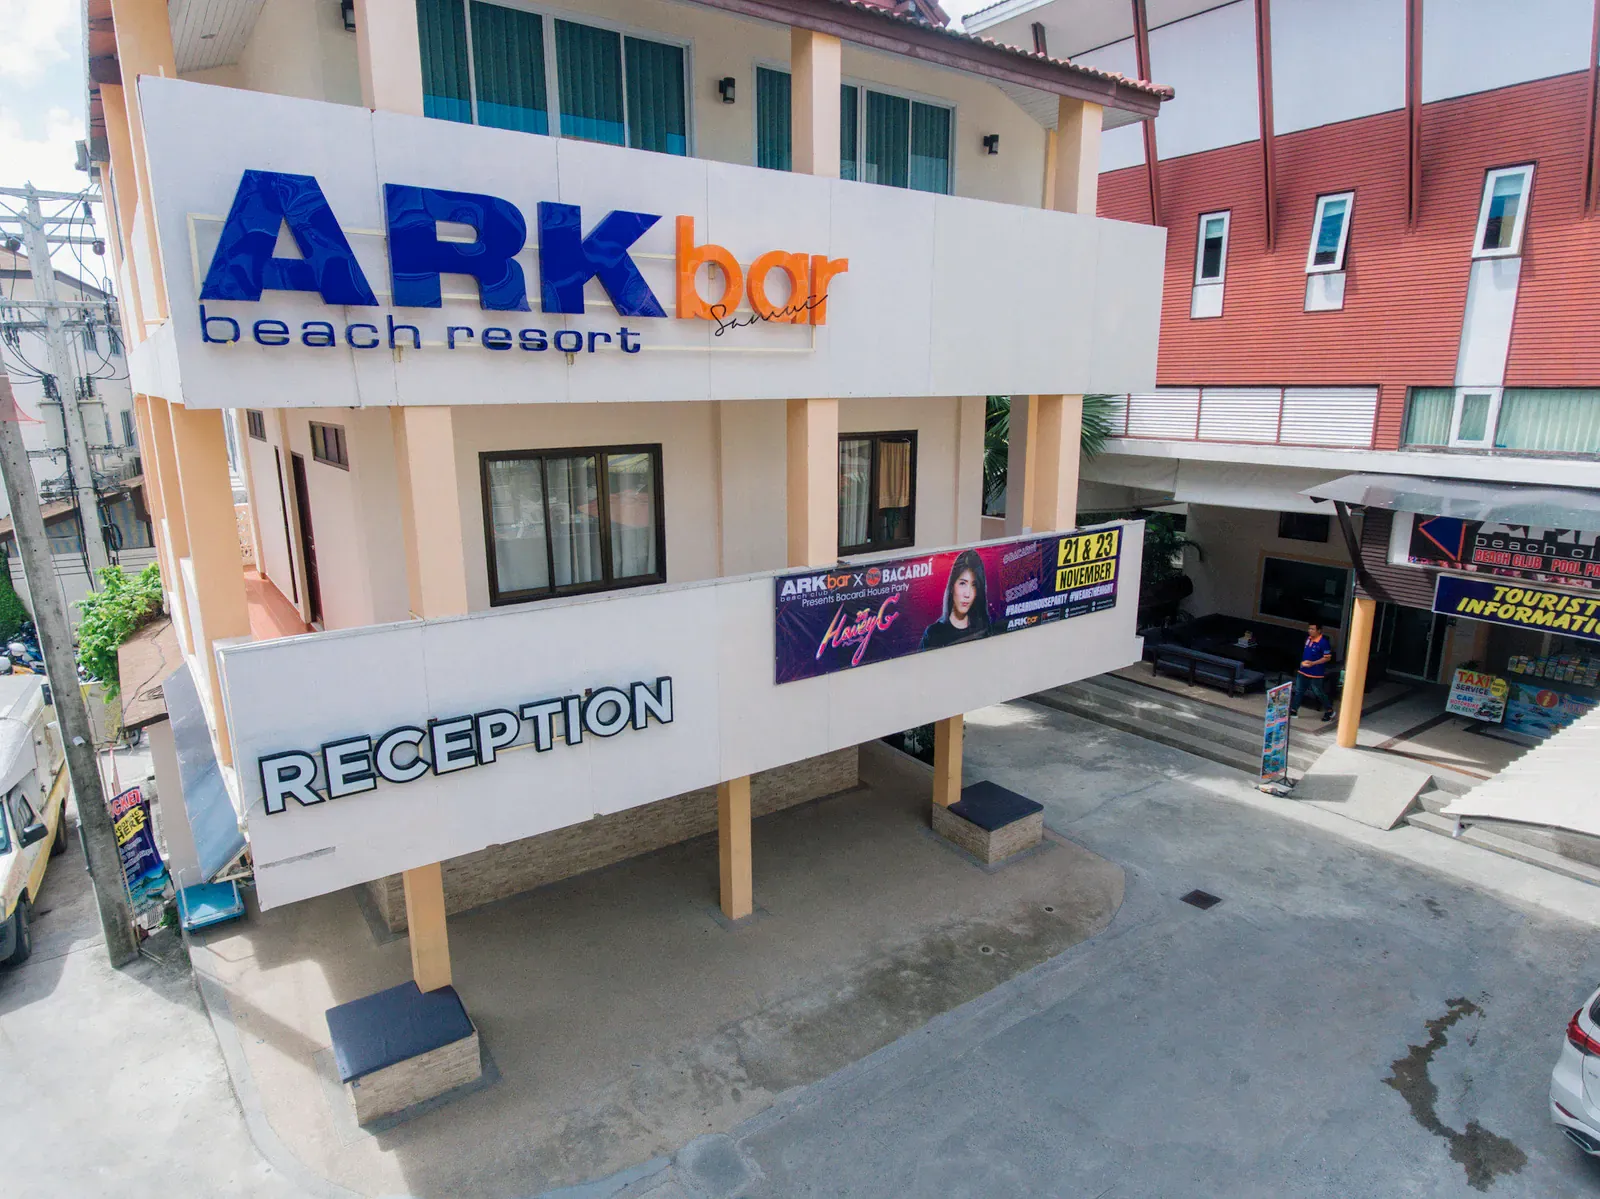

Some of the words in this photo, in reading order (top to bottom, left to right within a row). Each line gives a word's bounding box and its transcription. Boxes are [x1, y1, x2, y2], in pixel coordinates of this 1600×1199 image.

[200, 304, 421, 349] beach
[447, 322, 641, 354] resort
[1062, 537, 1079, 565] 21
[1082, 538, 1092, 561] &
[1095, 532, 1114, 559] 23
[1475, 534, 1556, 555] beach
[882, 557, 934, 584] BACARDÍ
[1059, 561, 1112, 590] NOVEMBER
[1474, 549, 1511, 566] BEACH
[1513, 553, 1543, 570] CLUB
[1551, 558, 1582, 575] POOL
[780, 593, 808, 603] beach
[810, 590, 829, 598] club
[801, 592, 835, 608] Presents
[867, 584, 890, 598] House
[891, 582, 910, 594] Party
[1493, 586, 1600, 617] TOURIST
[1455, 683, 1489, 696] SERVICE
[1456, 694, 1474, 703] CAR
[258, 676, 674, 815] RECEPTION
[117, 816, 148, 843] HERE
